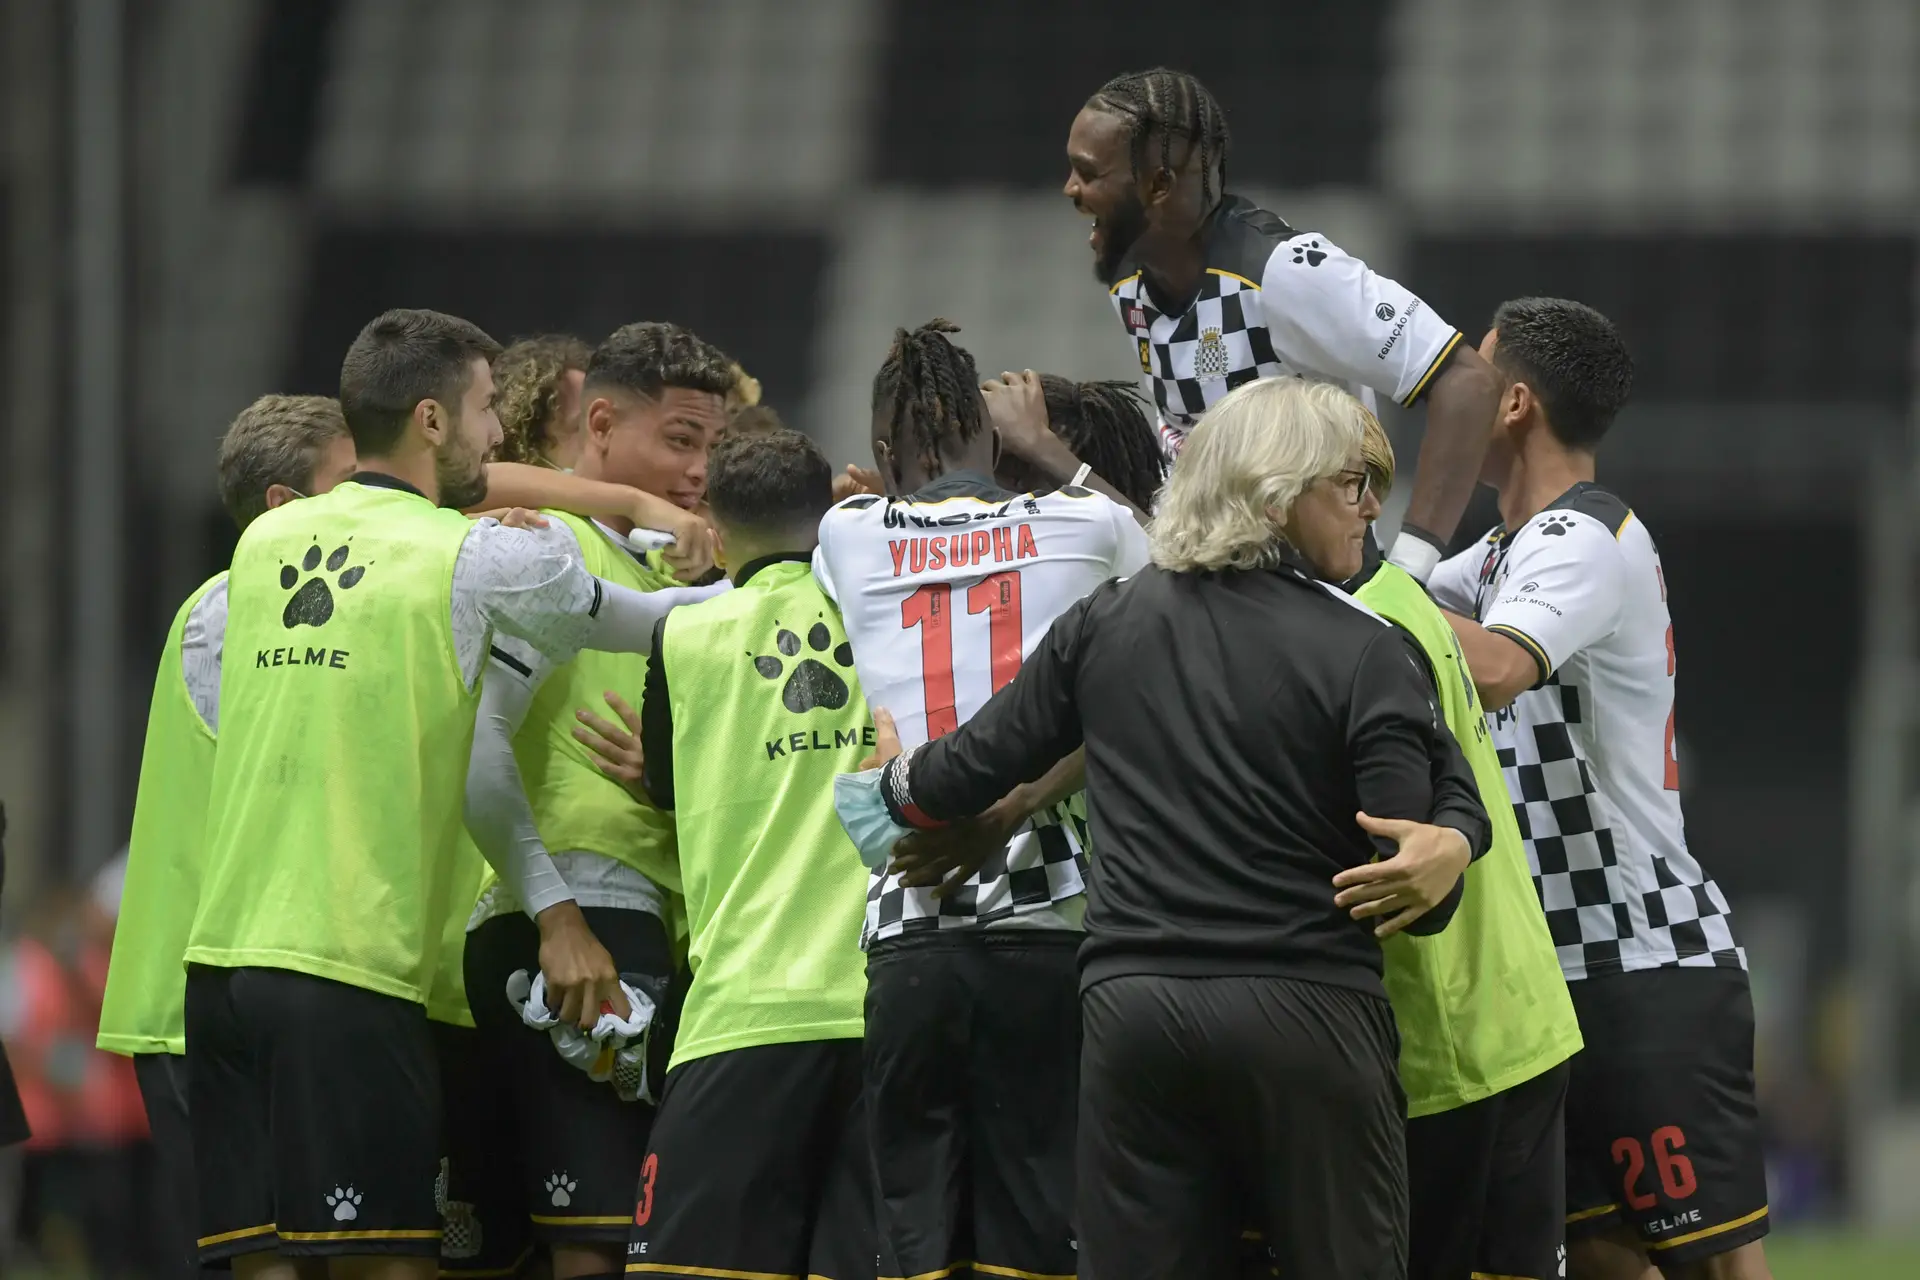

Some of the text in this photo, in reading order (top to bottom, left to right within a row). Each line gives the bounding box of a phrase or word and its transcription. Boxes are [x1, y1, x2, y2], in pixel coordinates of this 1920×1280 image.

[1377, 316, 1408, 360] EQUAÇÃO
[888, 523, 1039, 577] YUSUPHA
[1528, 598, 1563, 617] MOTOR
[256, 646, 350, 670] KELME
[901, 571, 1023, 742] 11
[765, 726, 877, 761] KELME
[1610, 1125, 1697, 1211] 26
[1645, 1209, 1702, 1235] ELME
